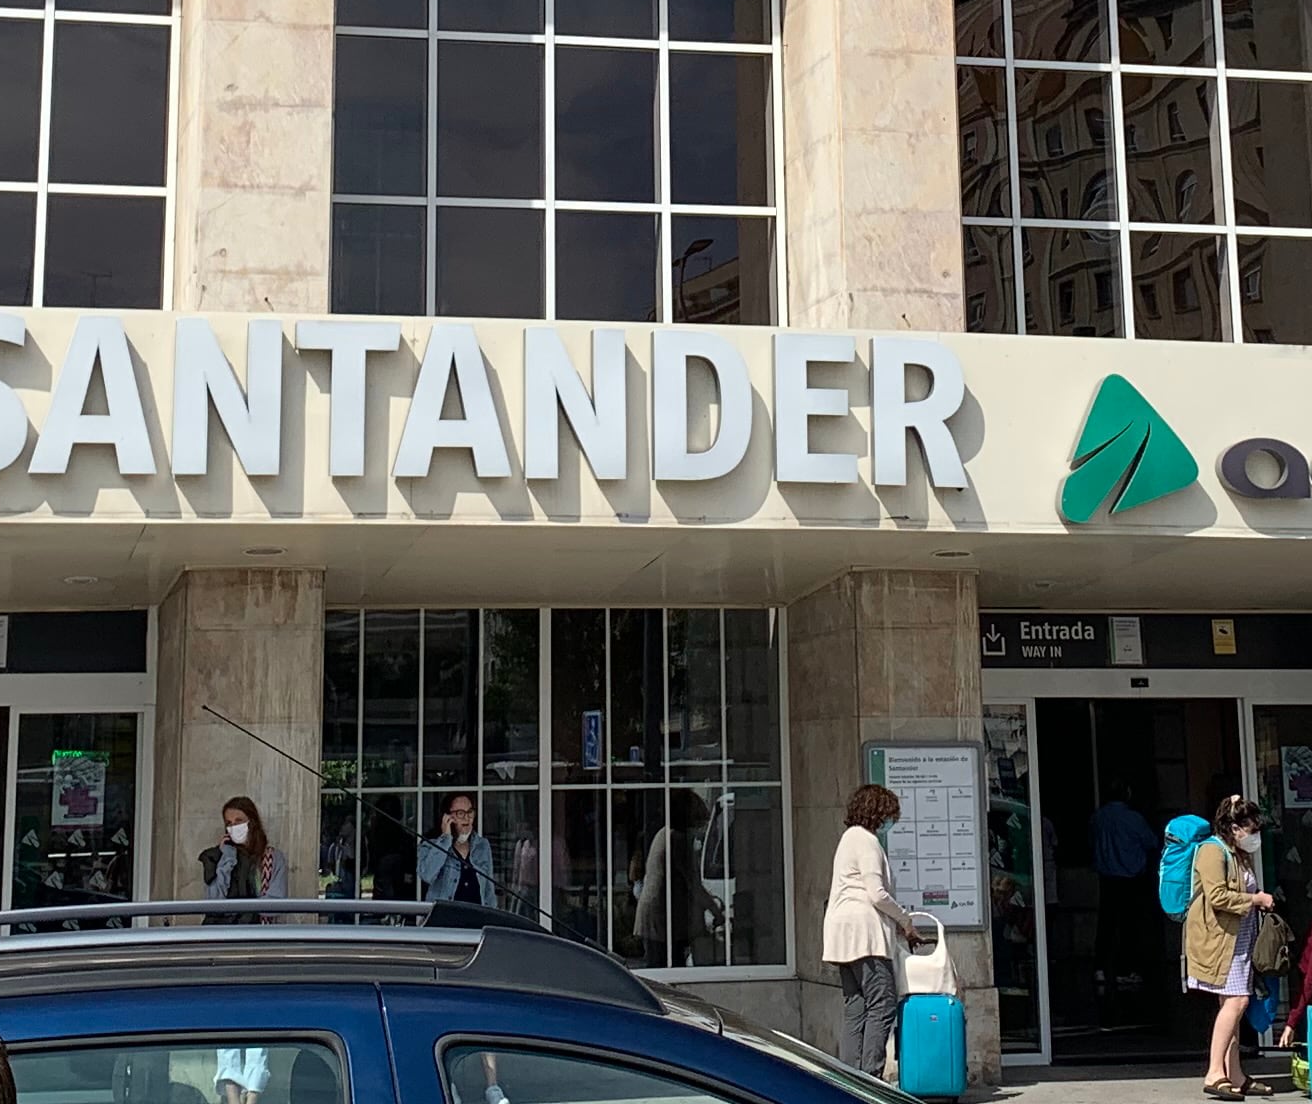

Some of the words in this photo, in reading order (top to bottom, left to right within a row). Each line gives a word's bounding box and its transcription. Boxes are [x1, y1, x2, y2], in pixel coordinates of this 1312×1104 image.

[1020, 621, 1095, 640] Entrada
[1022, 646, 1046, 658] WAY
[1050, 646, 1062, 658] IN
